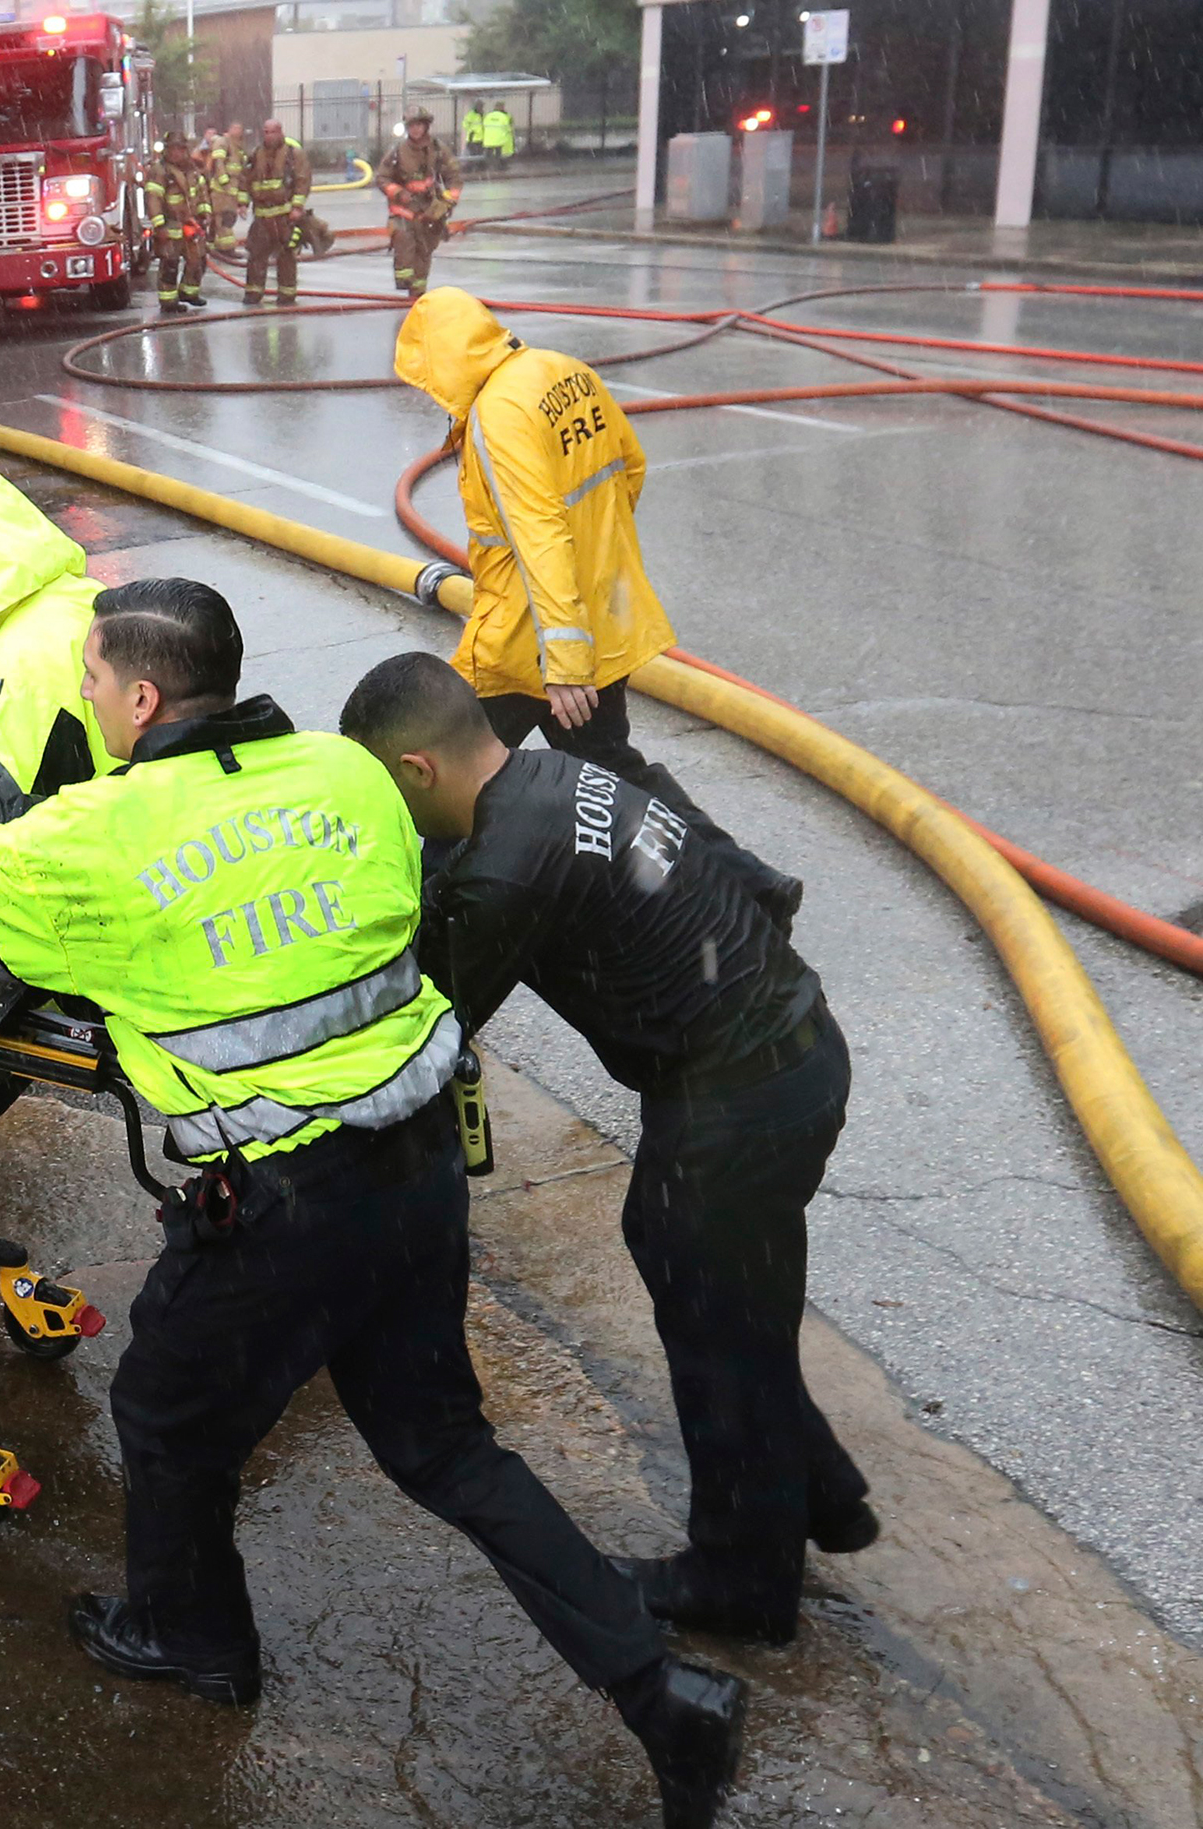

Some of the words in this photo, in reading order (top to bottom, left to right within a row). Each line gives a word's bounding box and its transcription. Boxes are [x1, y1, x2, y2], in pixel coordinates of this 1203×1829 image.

[104, 250, 114, 277] 1
[560, 405, 607, 456] FRE
[575, 762, 620, 862] HOUST
[630, 797, 688, 878] FIR
[134, 807, 361, 912] HOUSTON
[198, 880, 359, 969] FIRE
